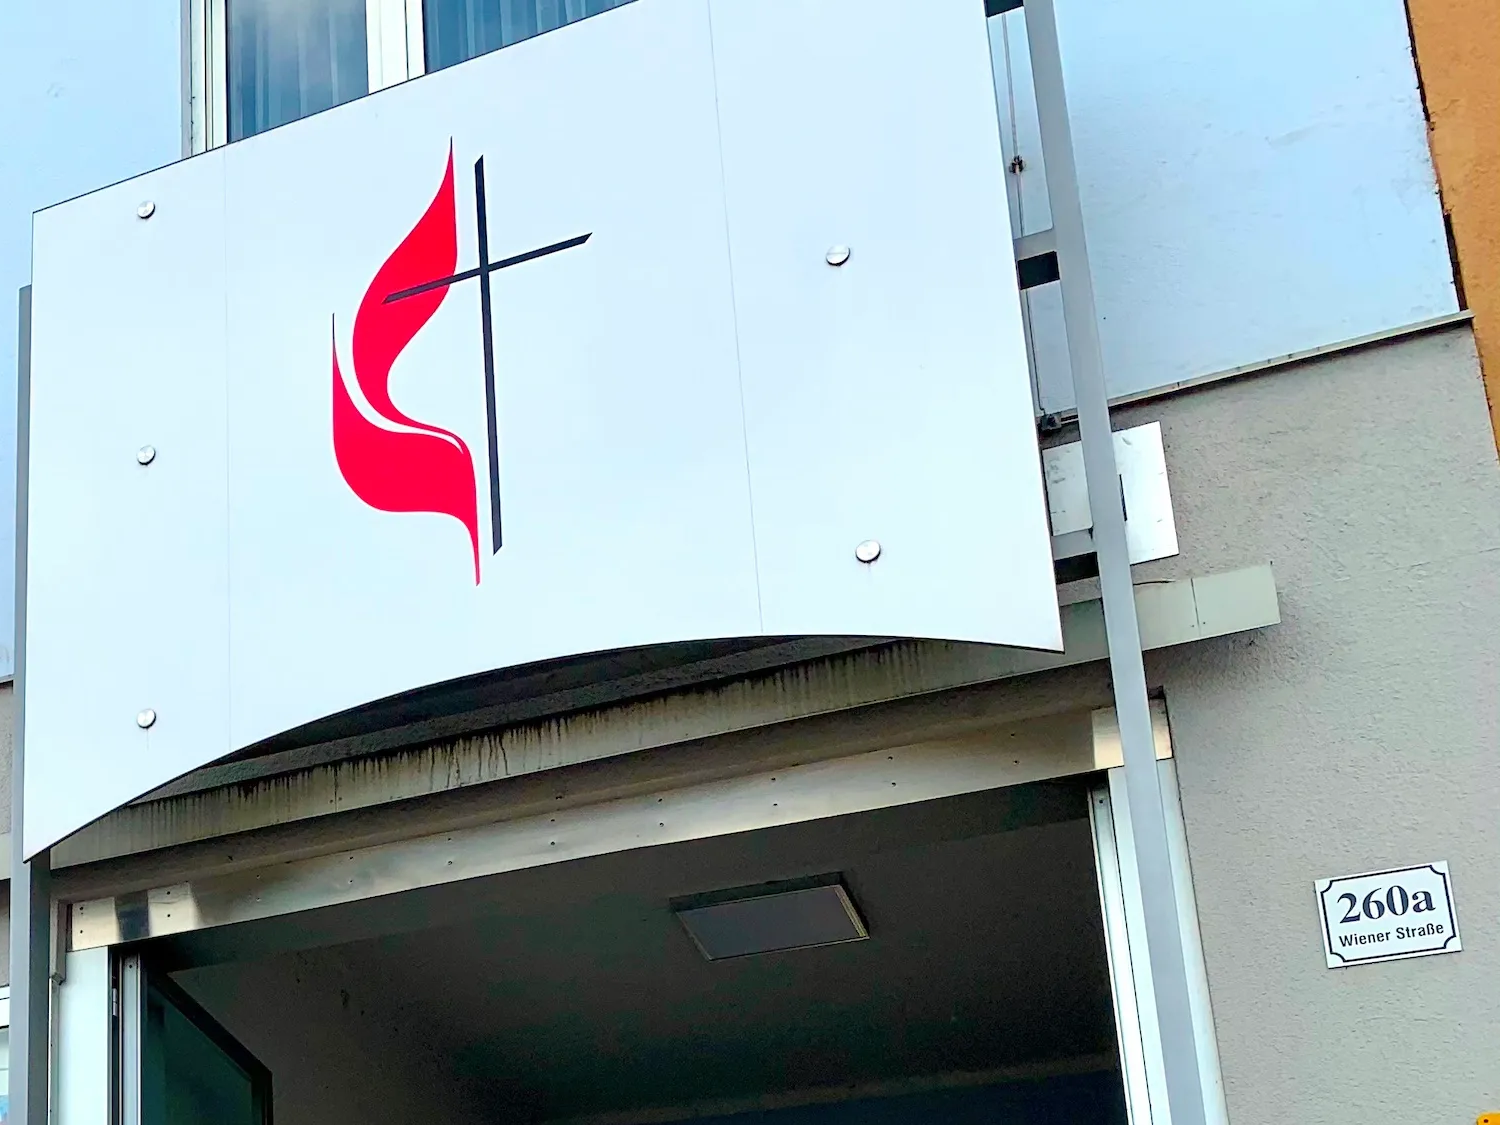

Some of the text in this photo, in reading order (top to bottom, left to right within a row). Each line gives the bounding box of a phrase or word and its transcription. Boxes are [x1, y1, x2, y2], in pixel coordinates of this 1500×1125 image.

[1337, 885, 1436, 924] 260a
[1339, 923, 1445, 947] Wiener Straße
